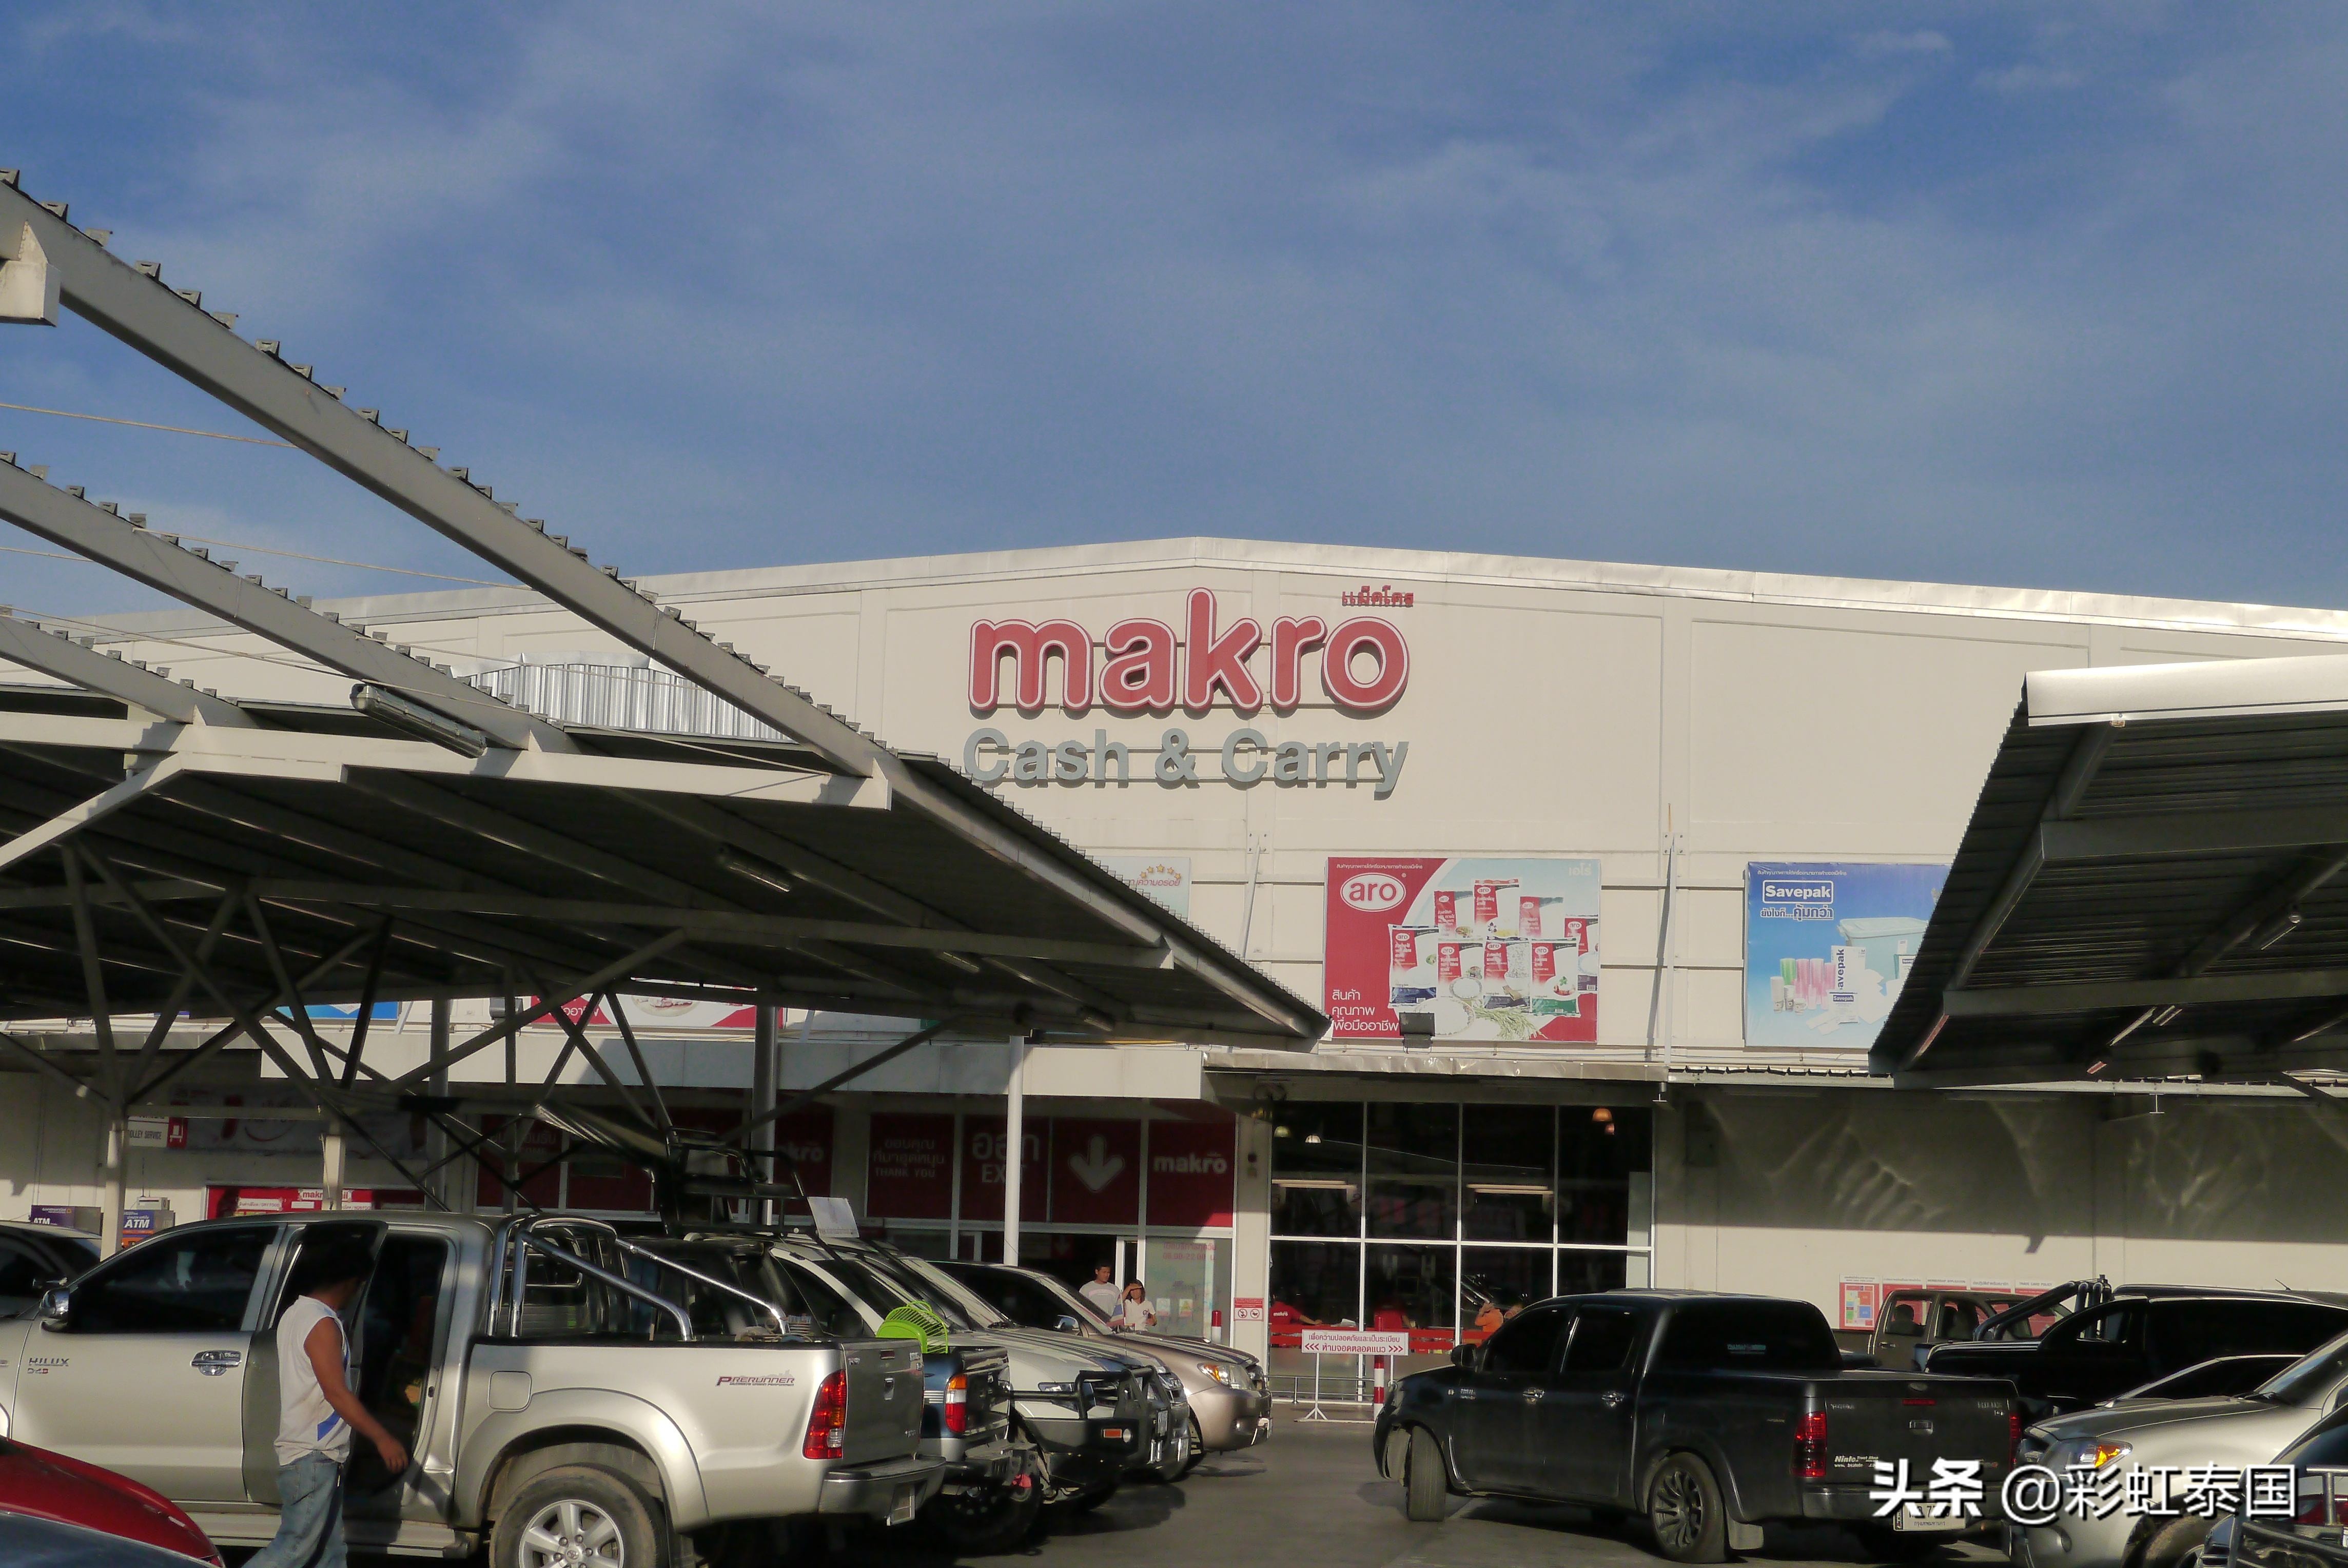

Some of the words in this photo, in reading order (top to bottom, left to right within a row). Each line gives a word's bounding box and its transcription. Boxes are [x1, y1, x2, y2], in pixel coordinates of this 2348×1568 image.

[1342, 585, 1414, 607] แม็คโคร
[969, 587, 1410, 711] makro
[964, 728, 1129, 783] Cash
[1155, 728, 1199, 783] &
[1222, 728, 1409, 794] Carry
[1349, 883, 1397, 901] aro
[1765, 885, 1831, 899] Savepak
[1836, 949, 1846, 989] avepak
[1332, 989, 1360, 1000] สินค้า
[1332, 1007, 1375, 1018] คุณภาพ
[1334, 1017, 1399, 1031] พื่อมืออาชีพ
[1153, 1152, 1228, 1174] makro
[875, 1167, 908, 1177] THANK
[914, 1168, 935, 1178] YOU
[124, 1219, 150, 1228] ATM
[1309, 1332, 1400, 1342] เพื่อความปลอดภัยและเป็นระเบียบ
[1322, 1343, 1385, 1353] ห้ามจอดตลอดแนว
[29, 1358, 69, 1366] HILUX
[717, 1377, 795, 1386] PRERUNNER
